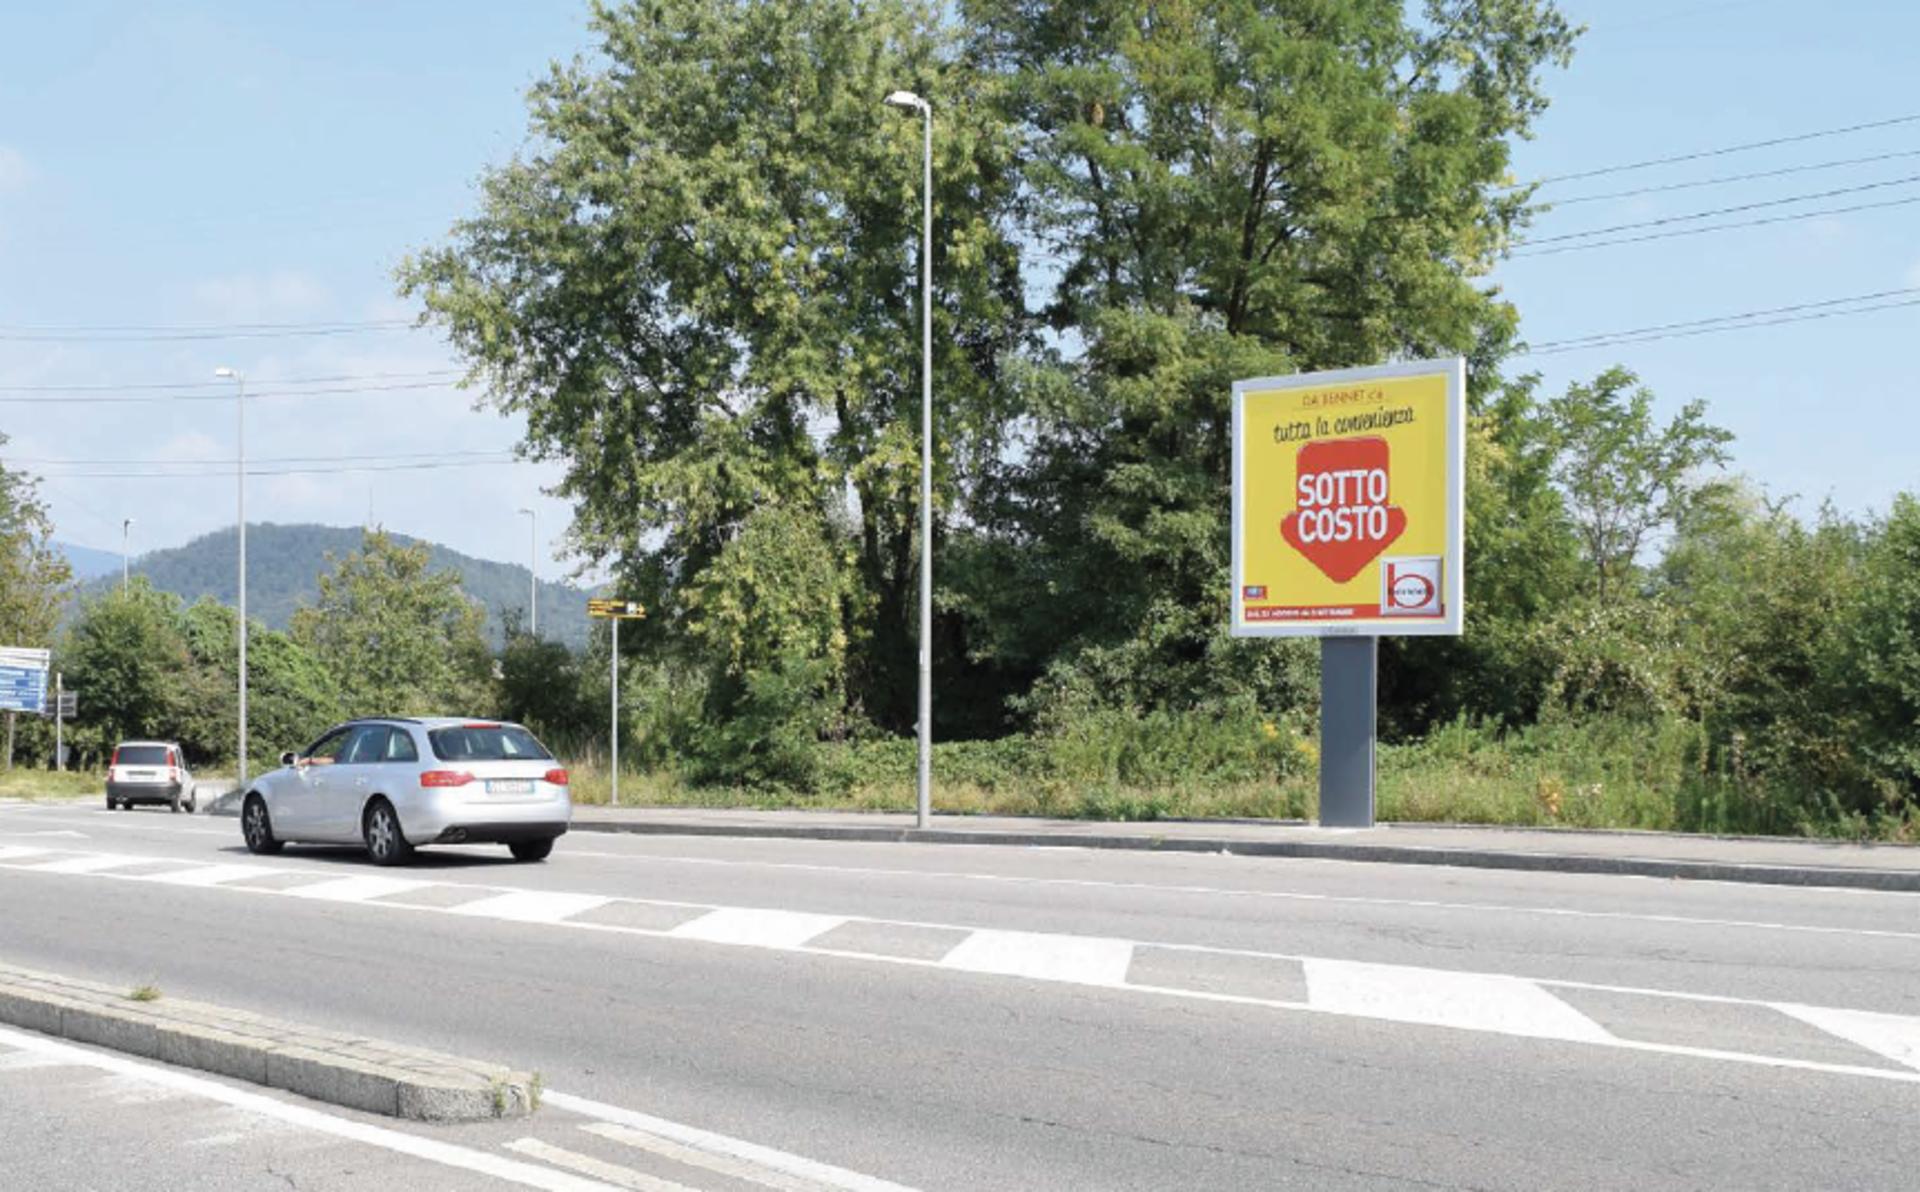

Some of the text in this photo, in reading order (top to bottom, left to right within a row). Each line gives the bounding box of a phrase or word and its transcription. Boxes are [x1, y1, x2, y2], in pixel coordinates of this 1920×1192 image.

[1274, 406, 1415, 443] tutta la convenienza
[1298, 468, 1387, 507] SOTTO
[1298, 504, 1388, 543] COSTO
